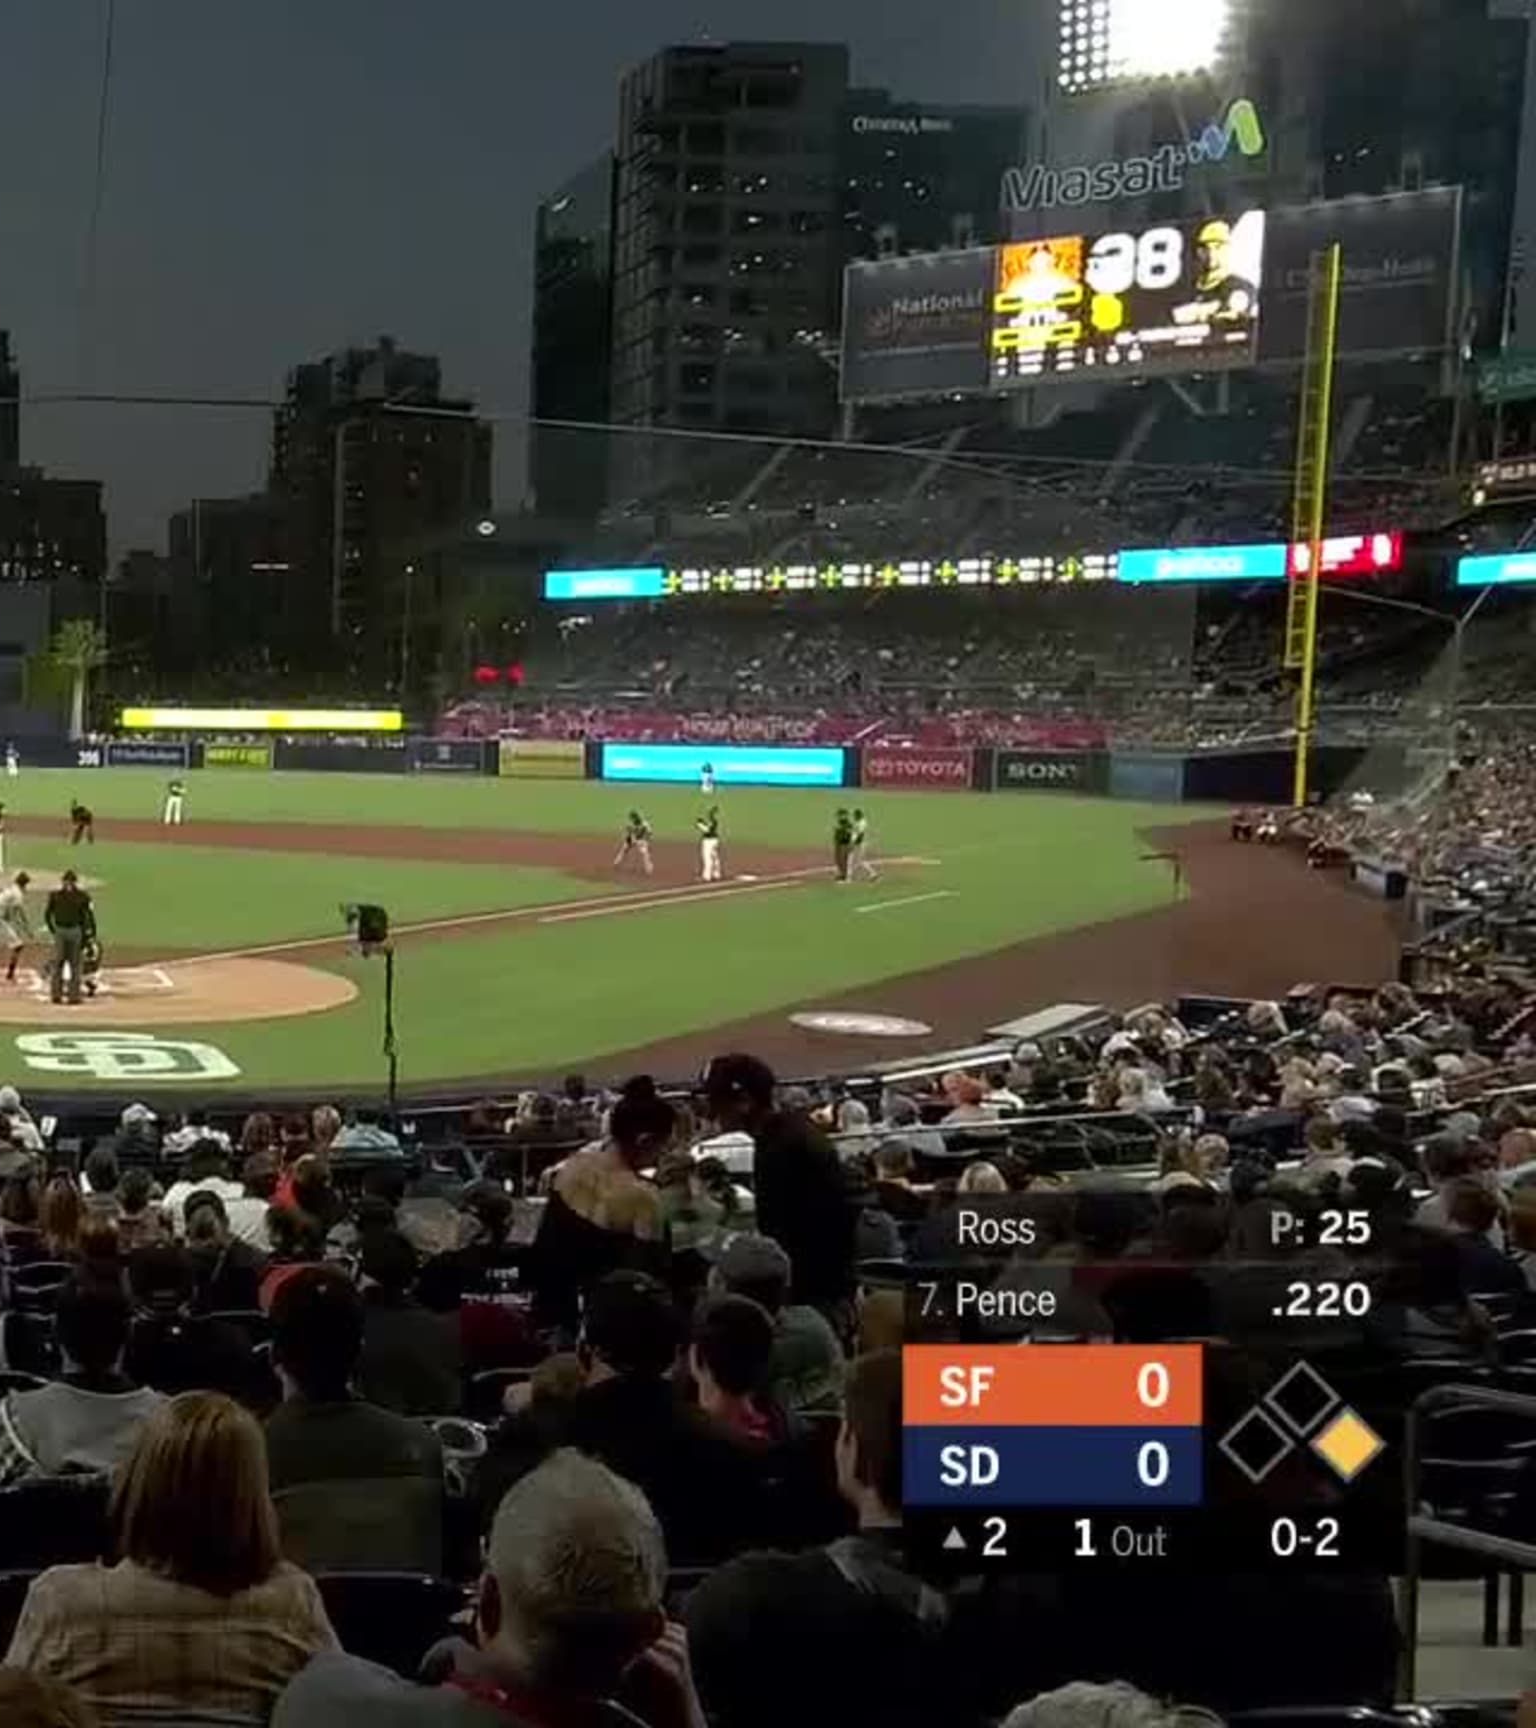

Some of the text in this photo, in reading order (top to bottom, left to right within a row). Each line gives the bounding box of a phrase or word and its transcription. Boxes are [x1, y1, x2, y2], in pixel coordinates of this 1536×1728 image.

[1000, 144, 1184, 211] Viasat
[896, 760, 966, 776] TOYOTA
[16, 1031, 242, 1080] SD
